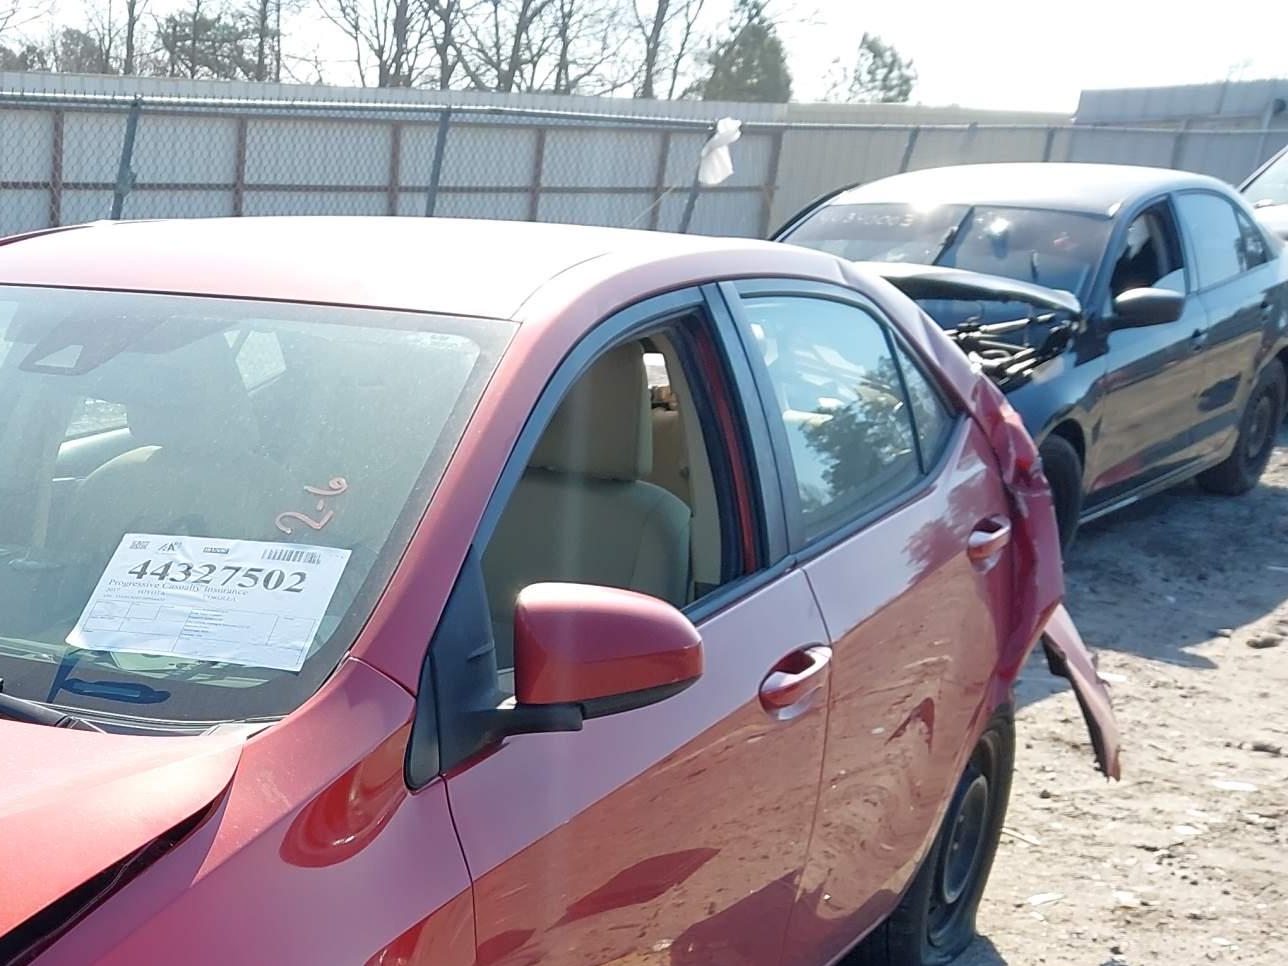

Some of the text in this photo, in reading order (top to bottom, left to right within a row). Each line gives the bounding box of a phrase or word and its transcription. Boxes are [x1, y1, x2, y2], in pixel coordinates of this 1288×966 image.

[108, 579, 249, 596] Progressive Casualty Insurance
[127, 559, 308, 593] 44327502
